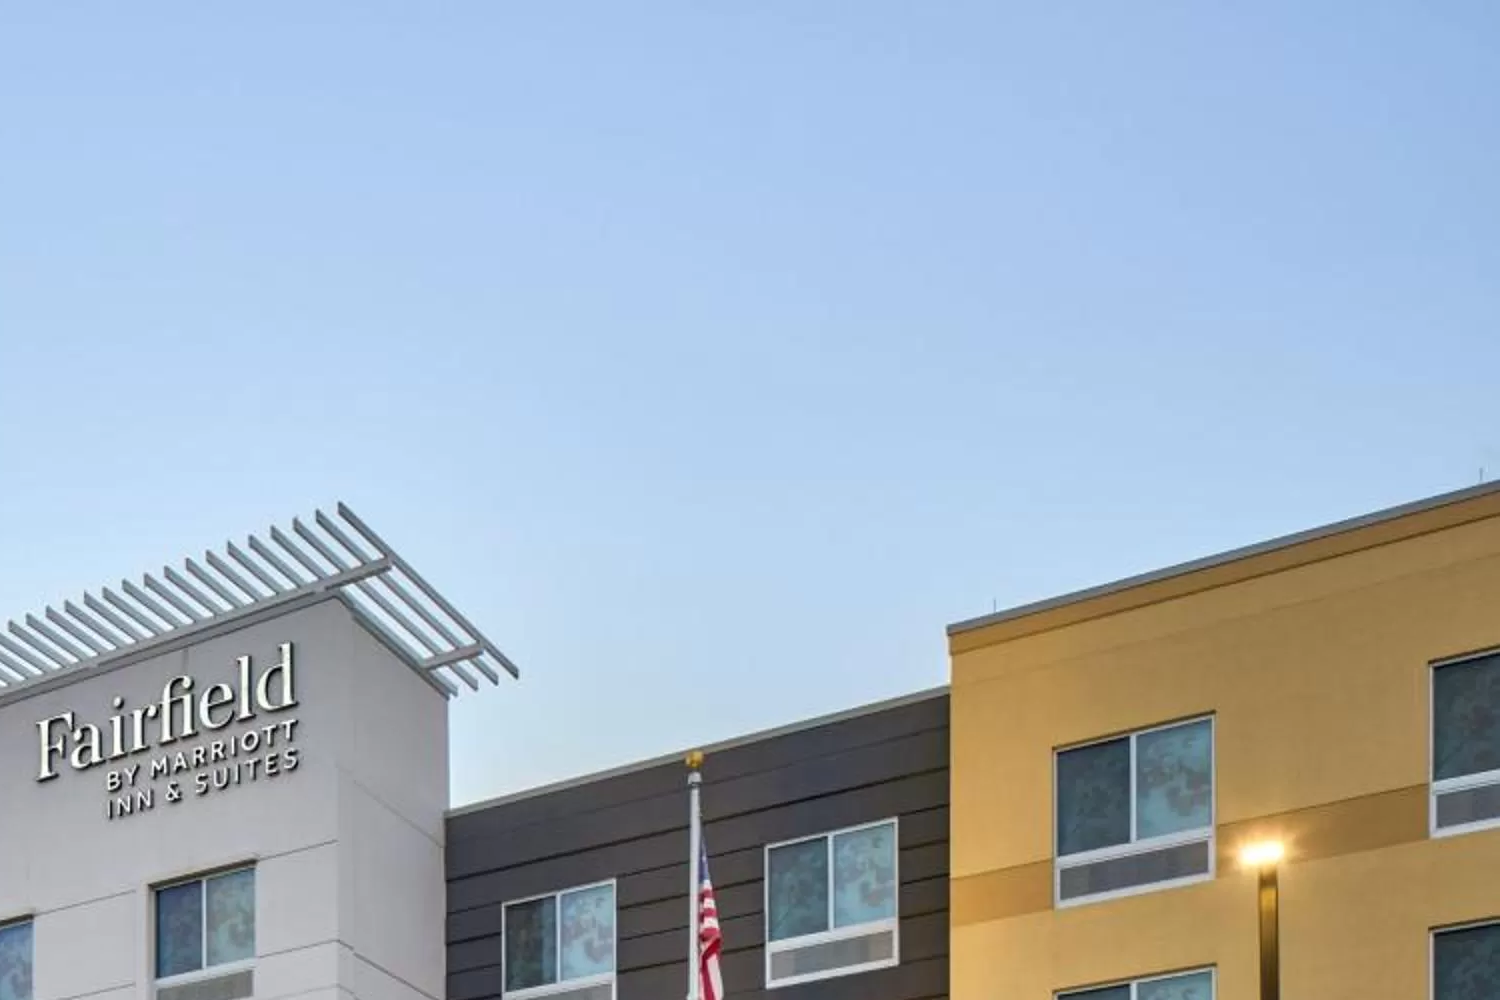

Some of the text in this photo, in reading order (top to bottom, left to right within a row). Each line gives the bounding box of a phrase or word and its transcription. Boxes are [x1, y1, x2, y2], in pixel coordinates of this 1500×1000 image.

[36, 641, 299, 782] Fairfield
[107, 719, 299, 792] BY MARRIOTT
[107, 748, 299, 819] INN & SUITES
